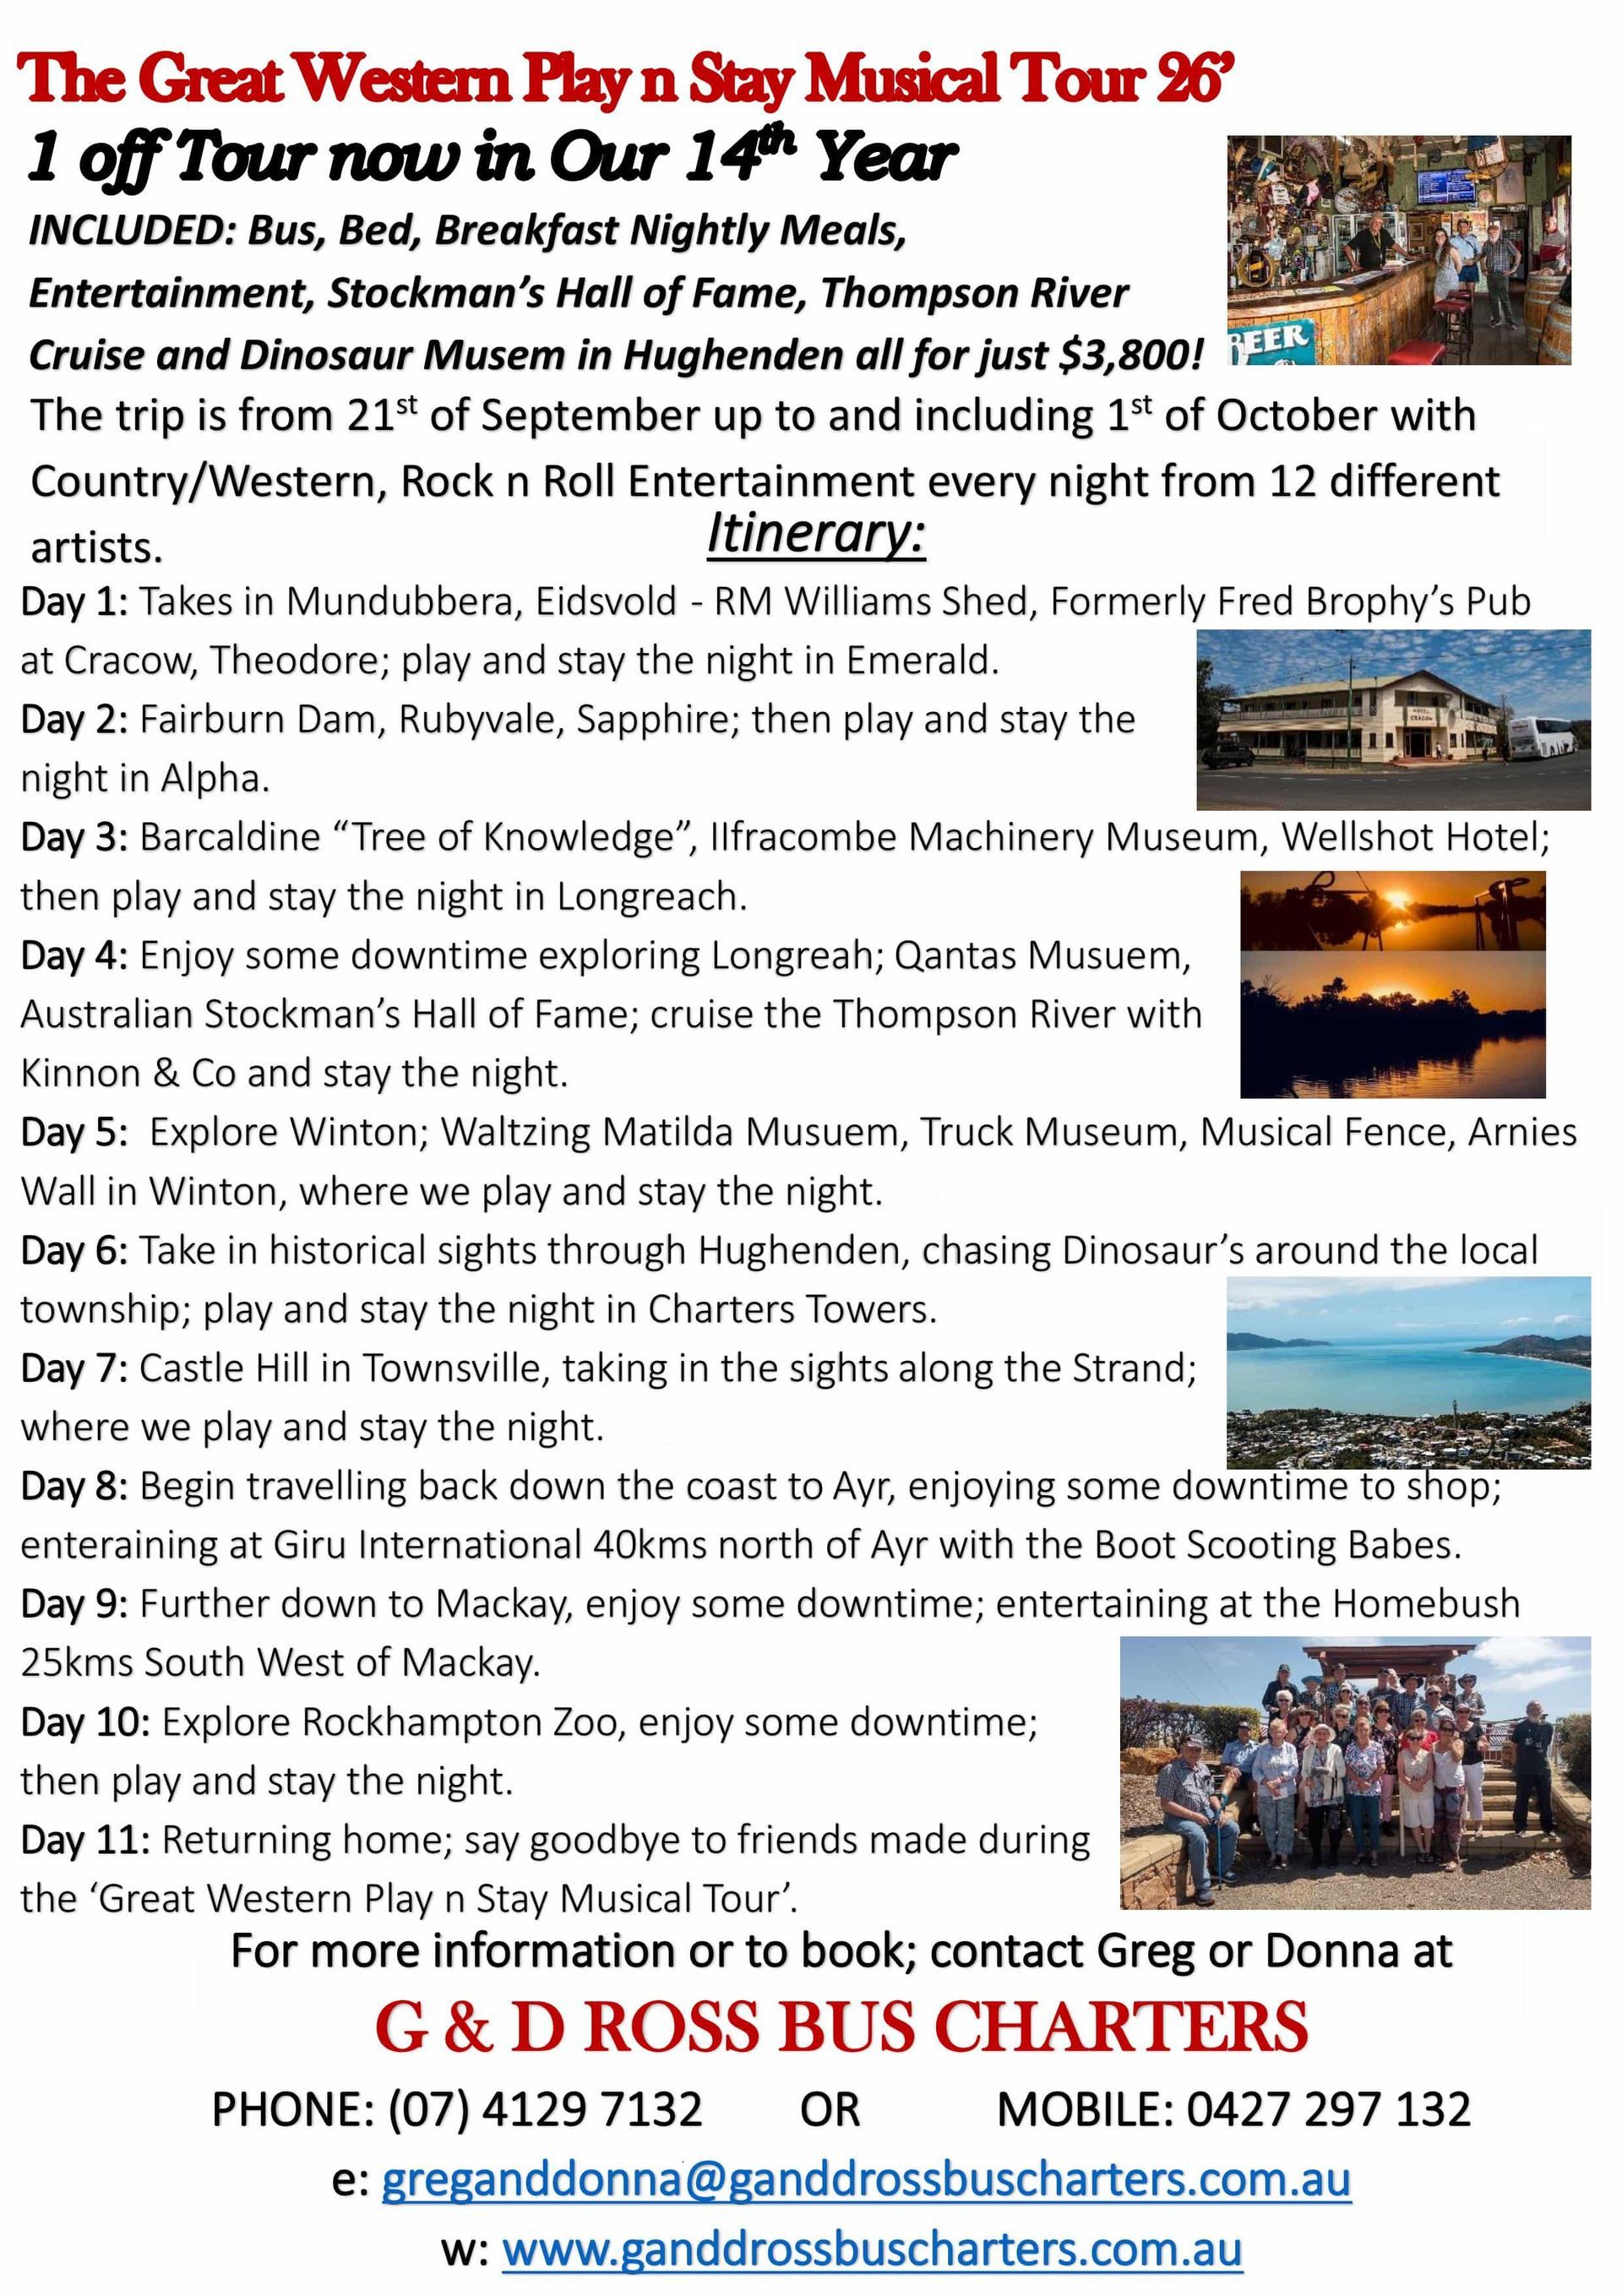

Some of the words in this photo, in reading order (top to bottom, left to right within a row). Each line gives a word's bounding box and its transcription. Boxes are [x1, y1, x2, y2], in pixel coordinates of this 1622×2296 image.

[16, 50, 127, 103] The
[139, 50, 286, 104] Great
[289, 51, 514, 103] Western
[522, 50, 634, 114] Play
[640, 67, 680, 102] n
[689, 50, 797, 114] Stay
[804, 50, 1002, 103] Musical
[1010, 51, 1148, 103] Tour
[27, 129, 57, 182] 1
[79, 127, 173, 197] off
[176, 129, 318, 182] Tour
[329, 141, 461, 182] now
[473, 127, 536, 182] in
[550, 128, 671, 182] Our
[685, 119, 798, 182] 14th
[815, 129, 961, 182] Year
[29, 214, 237, 246] INCLUDED:
[248, 214, 325, 252] Bus,
[339, 212, 421, 252] Bed,
[435, 211, 620, 253] Breakfast
[630, 212, 770, 253] Nightly
[780, 212, 906, 252] Meals,
[30, 337, 145, 371] Cruise
[156, 337, 231, 371] and
[240, 337, 415, 371] Dinosaur
[423, 339, 565, 371] Musem
[577, 337, 612, 370] in
[623, 337, 844, 378] Hughenden
[856, 337, 905, 371] all
[908, 336, 971, 378] for
[974, 337, 1050, 378] just
[1059, 334, 1205, 377] $3,800!
[1227, 325, 1309, 365] BEER
[30, 395, 102, 432] The
[115, 397, 184, 440] trip
[199, 397, 226, 432] is
[238, 395, 332, 432] from
[348, 394, 418, 431] 21st
[431, 395, 471, 432] of
[482, 395, 701, 439] September
[715, 405, 762, 440] up
[775, 400, 815, 432] to
[829, 396, 900, 432] and
[916, 395, 1094, 440] including
[1109, 394, 1153, 431] 1st
[1165, 395, 1206, 432] of
[1217, 395, 1379, 432] October
[1391, 395, 1475, 432] with
[31, 530, 161, 563] artists.
[705, 510, 928, 563] Itinerary:
[22, 585, 86, 623] Day
[97, 585, 127, 616] 1:
[139, 584, 232, 616] Takes
[245, 585, 273, 616] in
[288, 584, 522, 622] Mundubbera,
[537, 584, 675, 616] Eidsvold
[716, 586, 770, 616] RM
[784, 584, 931, 616] Williams
[942, 584, 1037, 622] Shed,
[1053, 584, 1206, 623] Formerly
[1219, 584, 1293, 616] Fred
[1468, 584, 1531, 616] Pub
[22, 703, 85, 742] Day
[96, 703, 127, 734] 2:
[142, 701, 284, 734] Fairburn
[299, 704, 385, 739] Dam,
[401, 701, 563, 741] Rubyvale,
[577, 702, 738, 741] Sapphire;
[751, 701, 830, 734] then
[845, 701, 914, 741] play
[924, 702, 987, 734] and
[1000, 706, 1068, 741] stay
[1078, 701, 1135, 733] the
[22, 760, 108, 800] night
[121, 762, 149, 792] in
[161, 760, 269, 800] Alpha.
[22, 1116, 85, 1155] Day
[95, 1116, 127, 1147] 5:
[151, 1114, 278, 1154] Explore
[289, 1116, 427, 1152] Winton;
[440, 1114, 591, 1154] Waltzing
[604, 1114, 732, 1146] Matilda
[748, 1117, 908, 1152] Musuem,
[919, 1114, 1014, 1146] Truck
[1026, 1117, 1187, 1152] Museum,
[1202, 1114, 1331, 1146] Musical
[1347, 1117, 1455, 1152] Fence,
[1467, 1116, 1577, 1146] Arnies
[19, 1292, 189, 1331] township;
[204, 1292, 273, 1331] play
[284, 1292, 347, 1324] and
[360, 1296, 428, 1331] stay
[438, 1292, 495, 1324] the
[509, 1292, 595, 1331] night
[607, 1293, 635, 1324] in
[649, 1292, 795, 1324] Charters
[805, 1294, 936, 1324] Towers.
[21, 1529, 218, 1567] enteraining
[230, 1532, 263, 1559] at
[275, 1529, 345, 1559] Giru
[361, 1527, 580, 1559] International
[593, 1527, 707, 1559] 40kms
[720, 1527, 813, 1559] north
[826, 1527, 862, 1559] of
[870, 1529, 928, 1567] Ayr
[939, 1527, 1013, 1559] with
[1026, 1527, 1082, 1559] the
[1097, 1529, 1176, 1559] Boot
[1187, 1529, 1336, 1567] Scooting
[1350, 1527, 1461, 1559] Babes.
[21, 1645, 133, 1677] 25kms
[144, 1645, 243, 1677] South
[257, 1647, 345, 1677] West
[357, 1645, 392, 1677] of
[404, 1645, 540, 1684] Mackay.
[22, 1706, 85, 1744] Day
[97, 1706, 149, 1737] 10:
[164, 1705, 290, 1744] Explore
[304, 1705, 542, 1744] Rockhampton
[553, 1706, 625, 1743] Zoo,
[640, 1706, 734, 1744] enjoy
[745, 1714, 838, 1737] some
[851, 1705, 1037, 1743] downtime;
[376, 1999, 429, 2053] G
[444, 1999, 494, 2053] &
[511, 2000, 565, 2052] D
[584, 1999, 759, 2053] ROSS
[778, 1999, 916, 2053] BUS
[935, 1999, 1309, 2053] CHARTERS
[214, 2091, 373, 2127] PHONE:
[389, 2087, 469, 2135] (07)
[482, 2091, 586, 2127] 4129
[601, 2091, 702, 2127] 7132
[801, 2091, 861, 2127] OR
[999, 2091, 1173, 2127] MOBILE:
[1187, 2091, 1291, 2127] 0427
[1305, 2091, 1381, 2127] 297
[1397, 2091, 1471, 2127] 132
[332, 2168, 367, 2196] e:
[381, 2157, 1353, 2206] greganddonna@ganddrossbuscharters.com.au
[440, 2239, 487, 2266] w:
[501, 2228, 1244, 2276] www.ganddrossbuscharters.com.au
